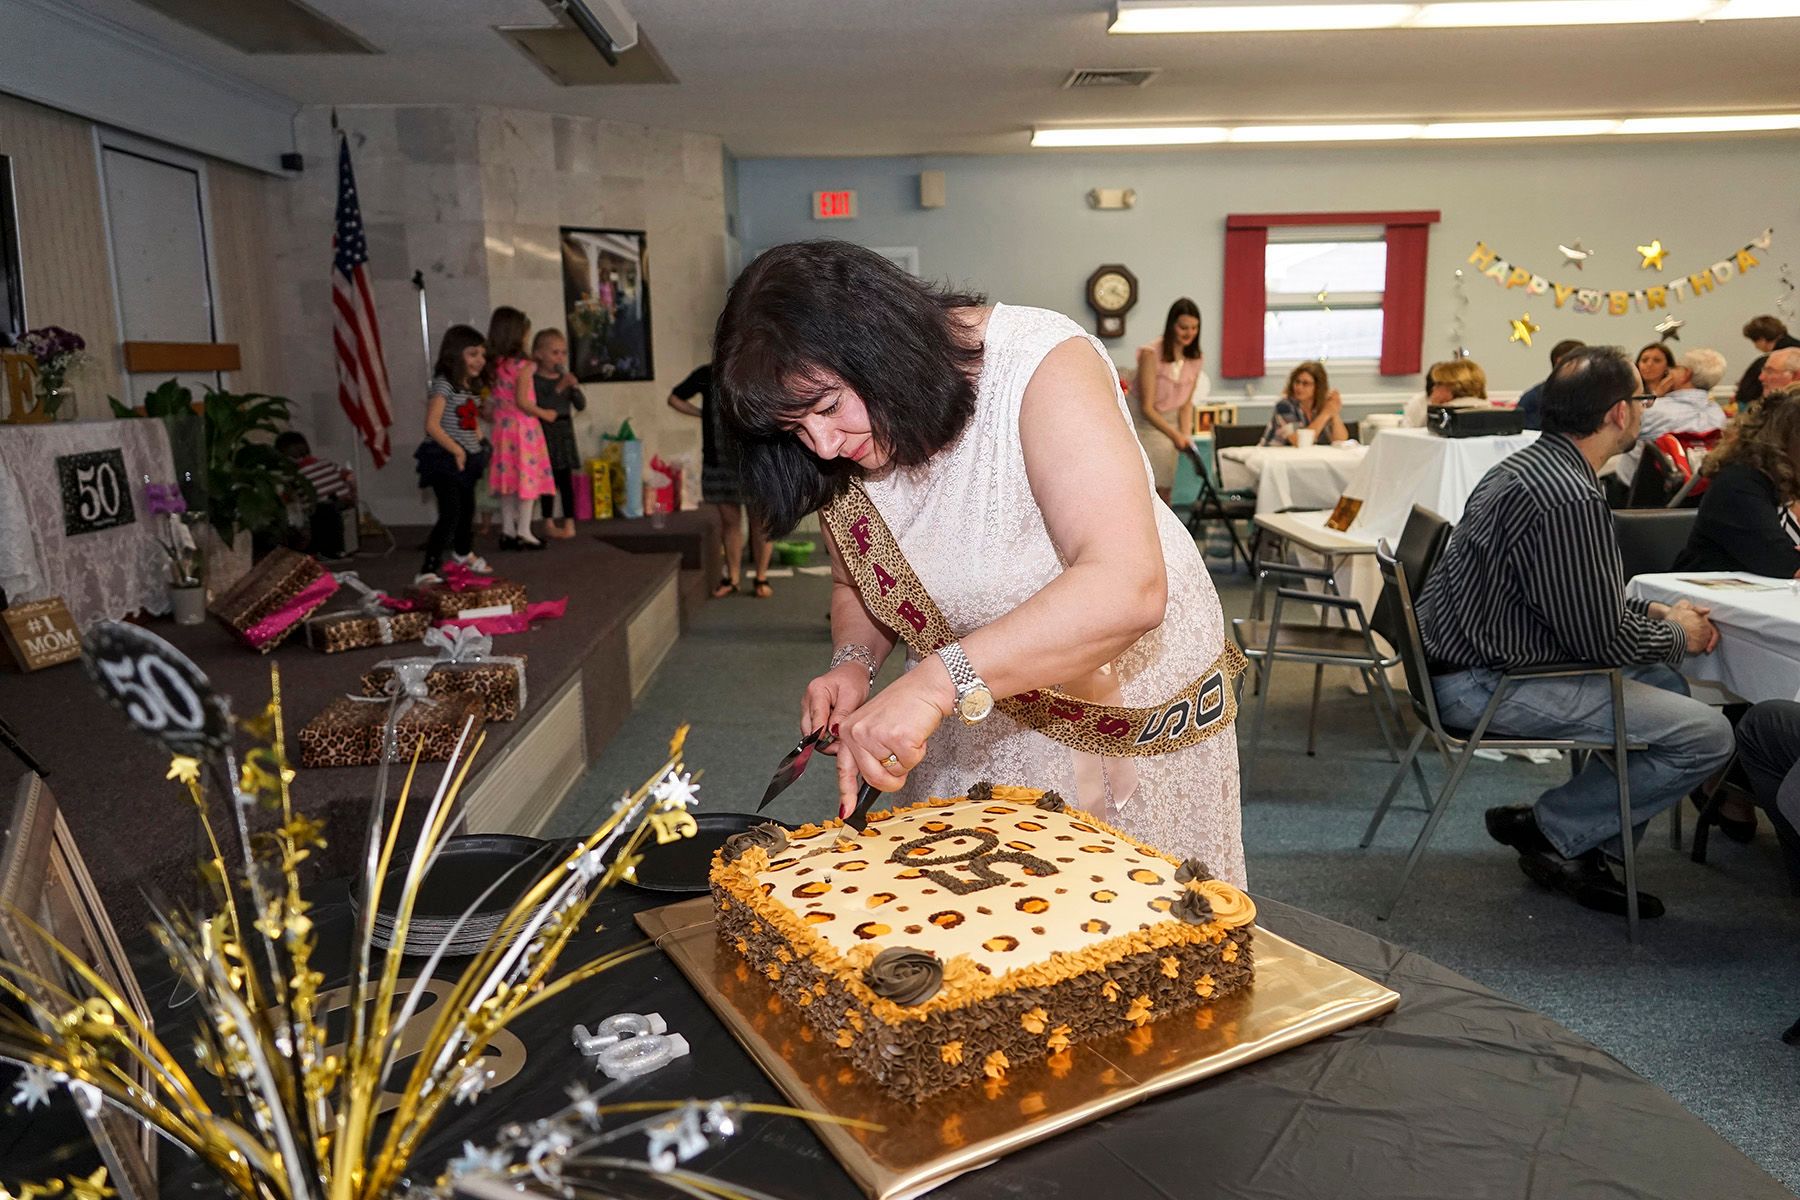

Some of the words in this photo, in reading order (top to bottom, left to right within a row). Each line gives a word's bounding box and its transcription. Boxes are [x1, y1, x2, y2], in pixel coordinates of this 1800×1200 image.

[1467, 240, 1574, 309] HAPPY
[77, 462, 120, 520] 50
[24, 628, 79, 656] MOM
[27, 614, 56, 634] #1
[98, 654, 205, 731] 50
[1134, 671, 1225, 746] 50
